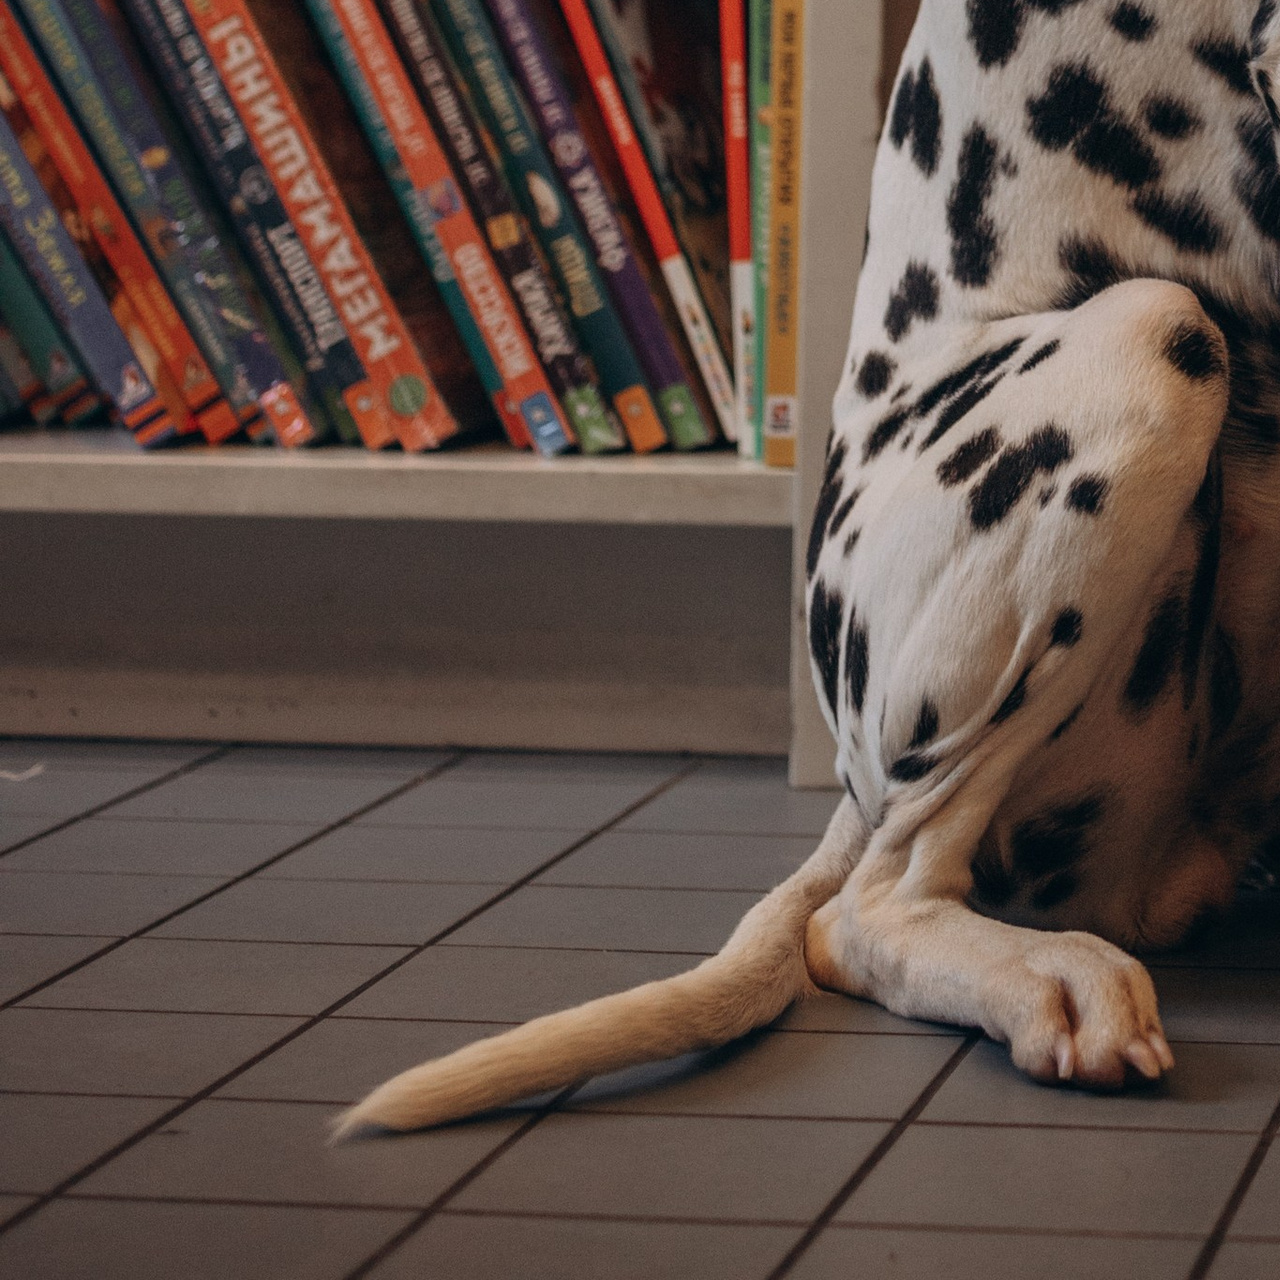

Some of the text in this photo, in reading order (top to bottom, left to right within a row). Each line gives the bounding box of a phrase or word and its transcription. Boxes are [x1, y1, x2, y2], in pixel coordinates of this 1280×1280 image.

[207, 16, 401, 362] МЕГАМАШИНЫ
[567, 167, 628, 275] ФИЗИКА
[266, 223, 348, 351] ТРАНСПОРТ
[454, 243, 531, 380] ИСКУССТВО
[511, 268, 577, 364] ХИМИЯ
